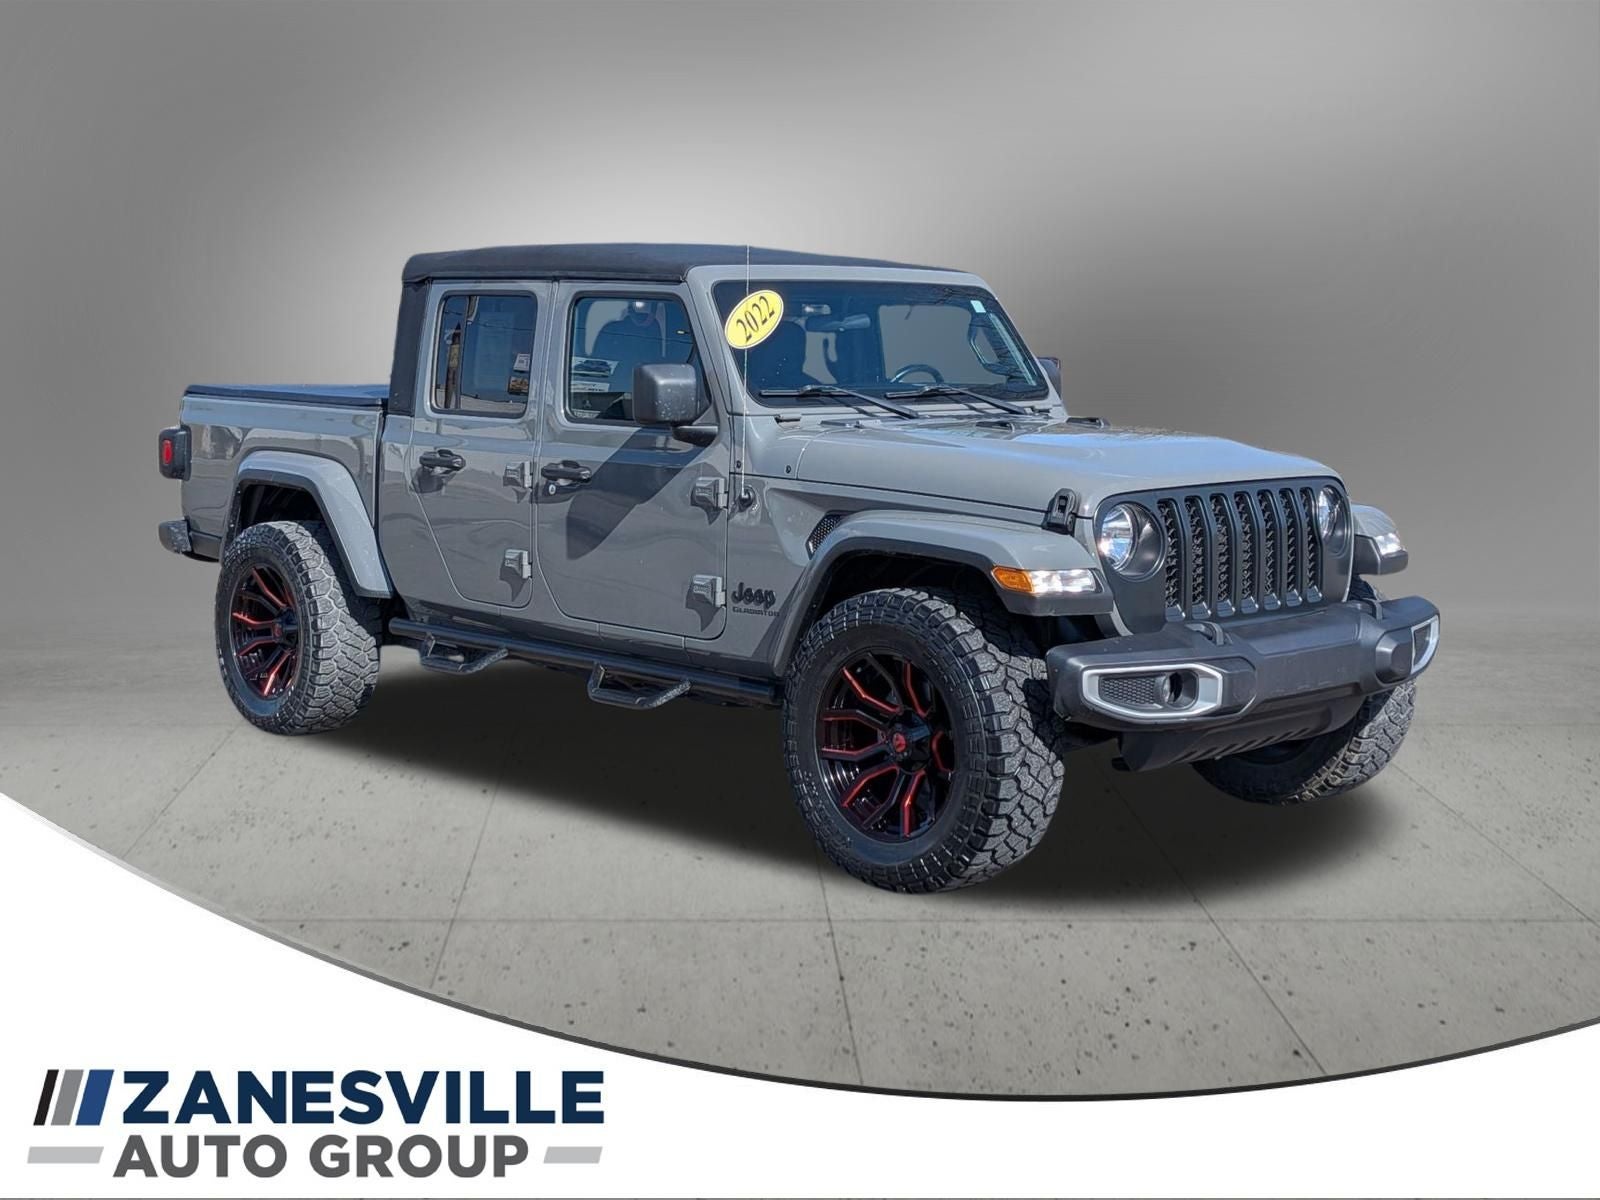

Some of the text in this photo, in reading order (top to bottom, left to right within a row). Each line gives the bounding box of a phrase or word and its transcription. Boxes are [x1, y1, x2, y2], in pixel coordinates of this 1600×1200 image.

[736, 296, 775, 342] 2022
[731, 582, 776, 609] Jeep
[732, 606, 780, 617] GLADIATOR
